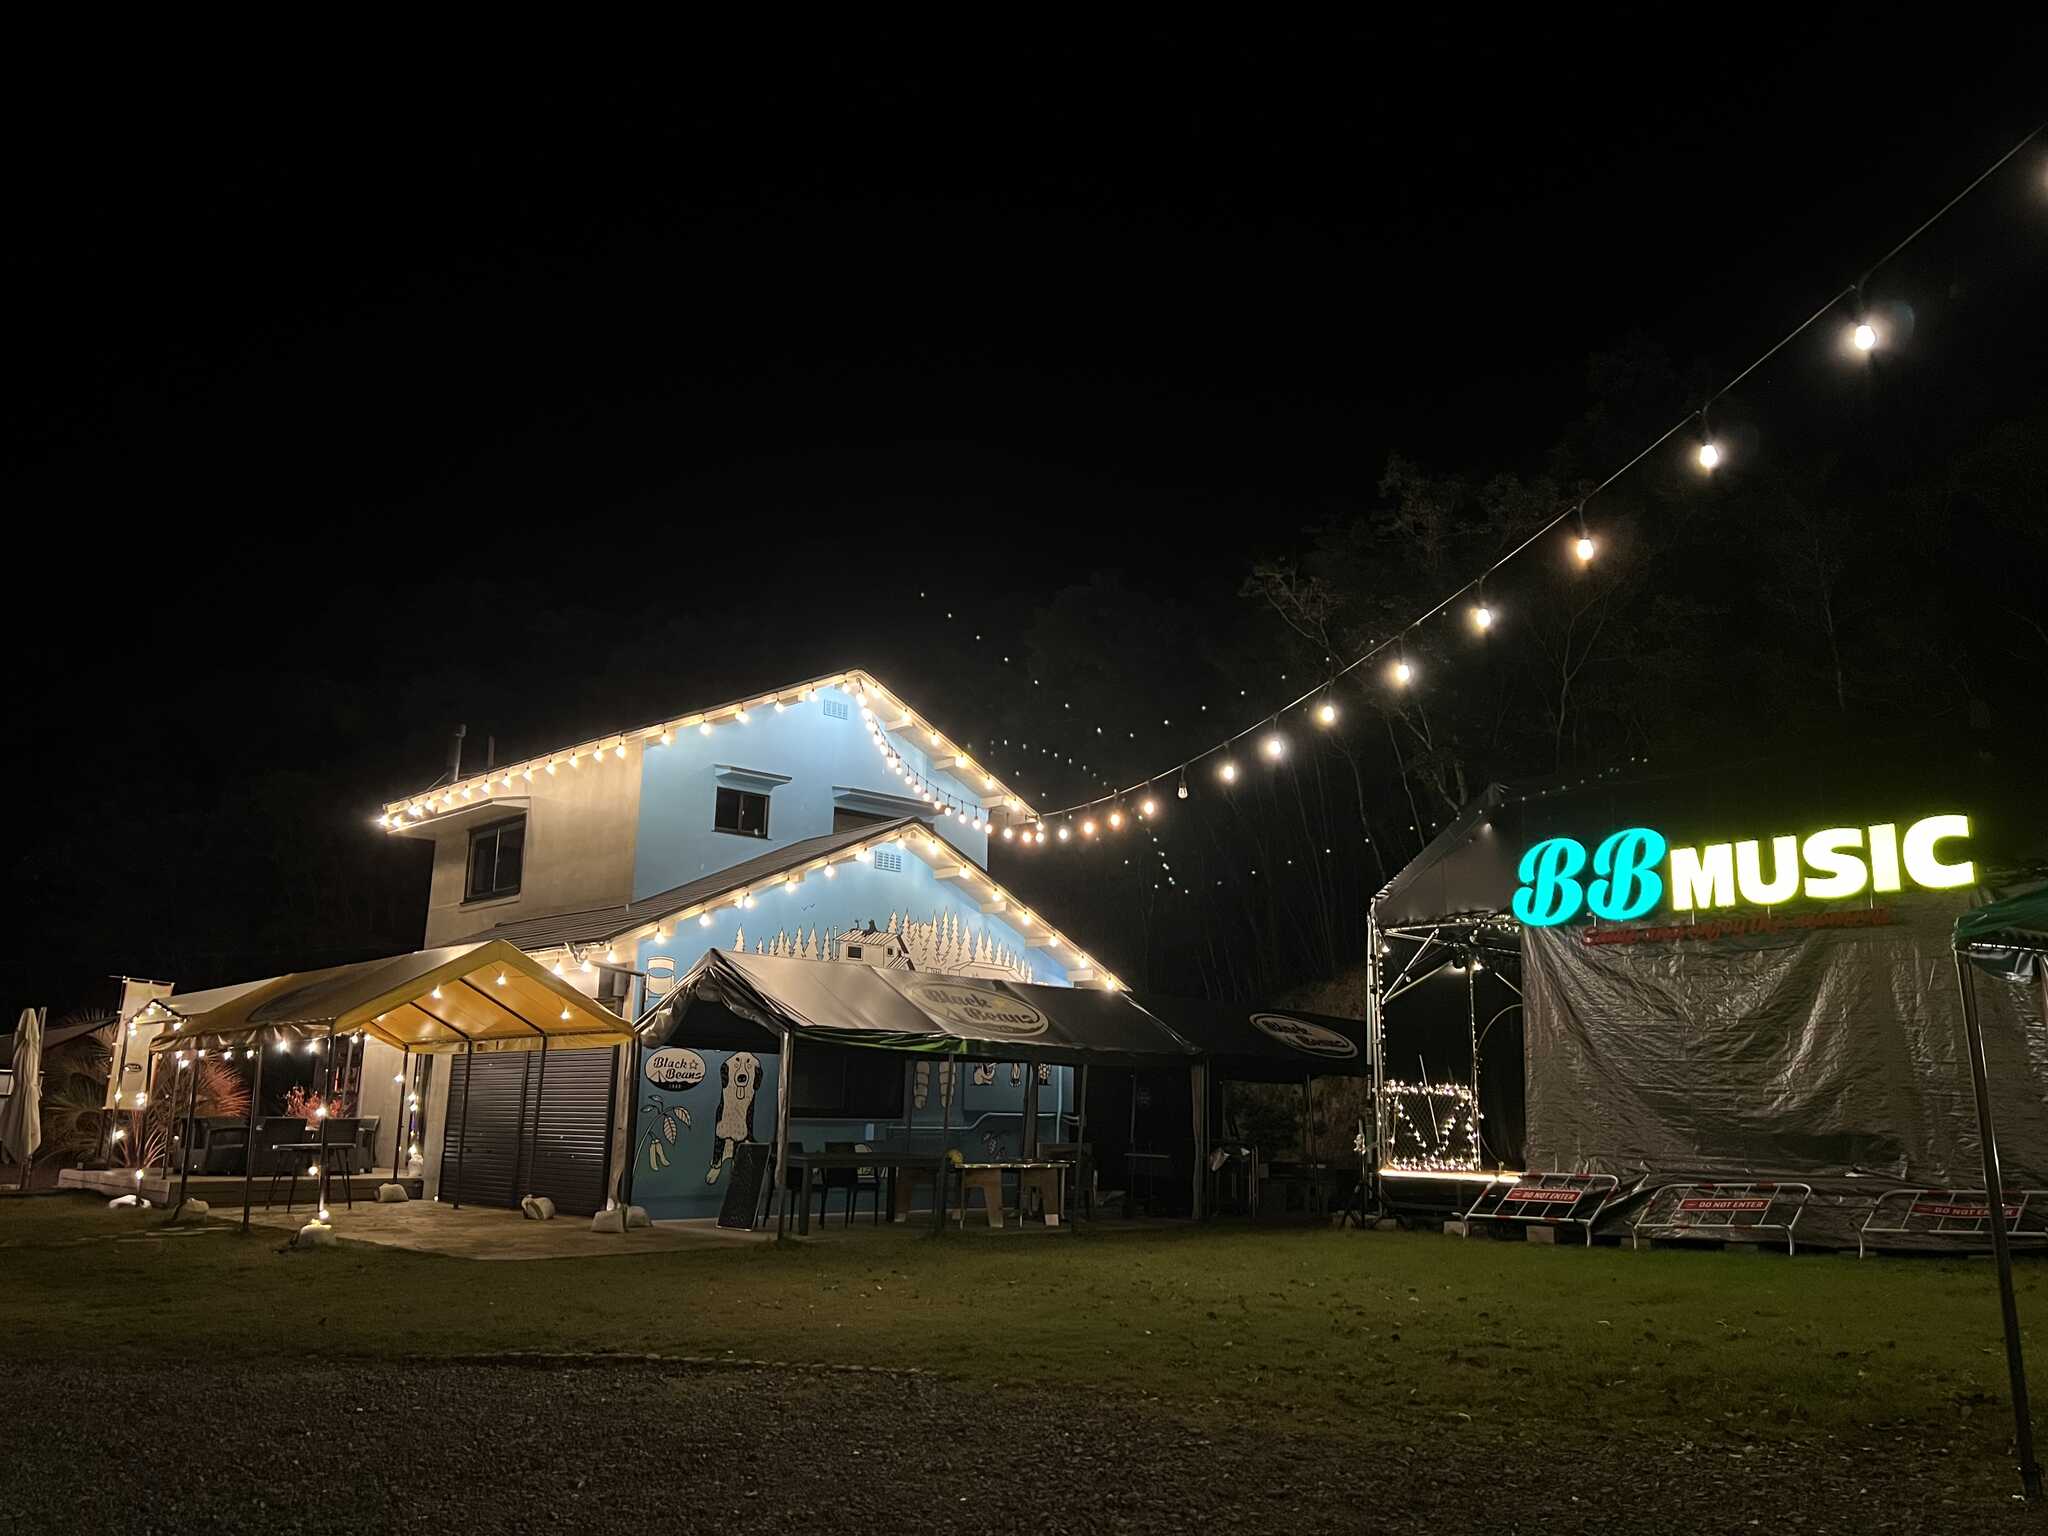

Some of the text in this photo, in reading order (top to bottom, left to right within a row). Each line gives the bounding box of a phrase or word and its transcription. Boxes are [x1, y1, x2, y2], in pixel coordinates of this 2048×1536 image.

[1512, 815, 1976, 927] BB MUSIC
[653, 1056, 688, 1069] Black
[665, 1068, 702, 1080] Beans
[1550, 1192, 1576, 1201] ENTER
